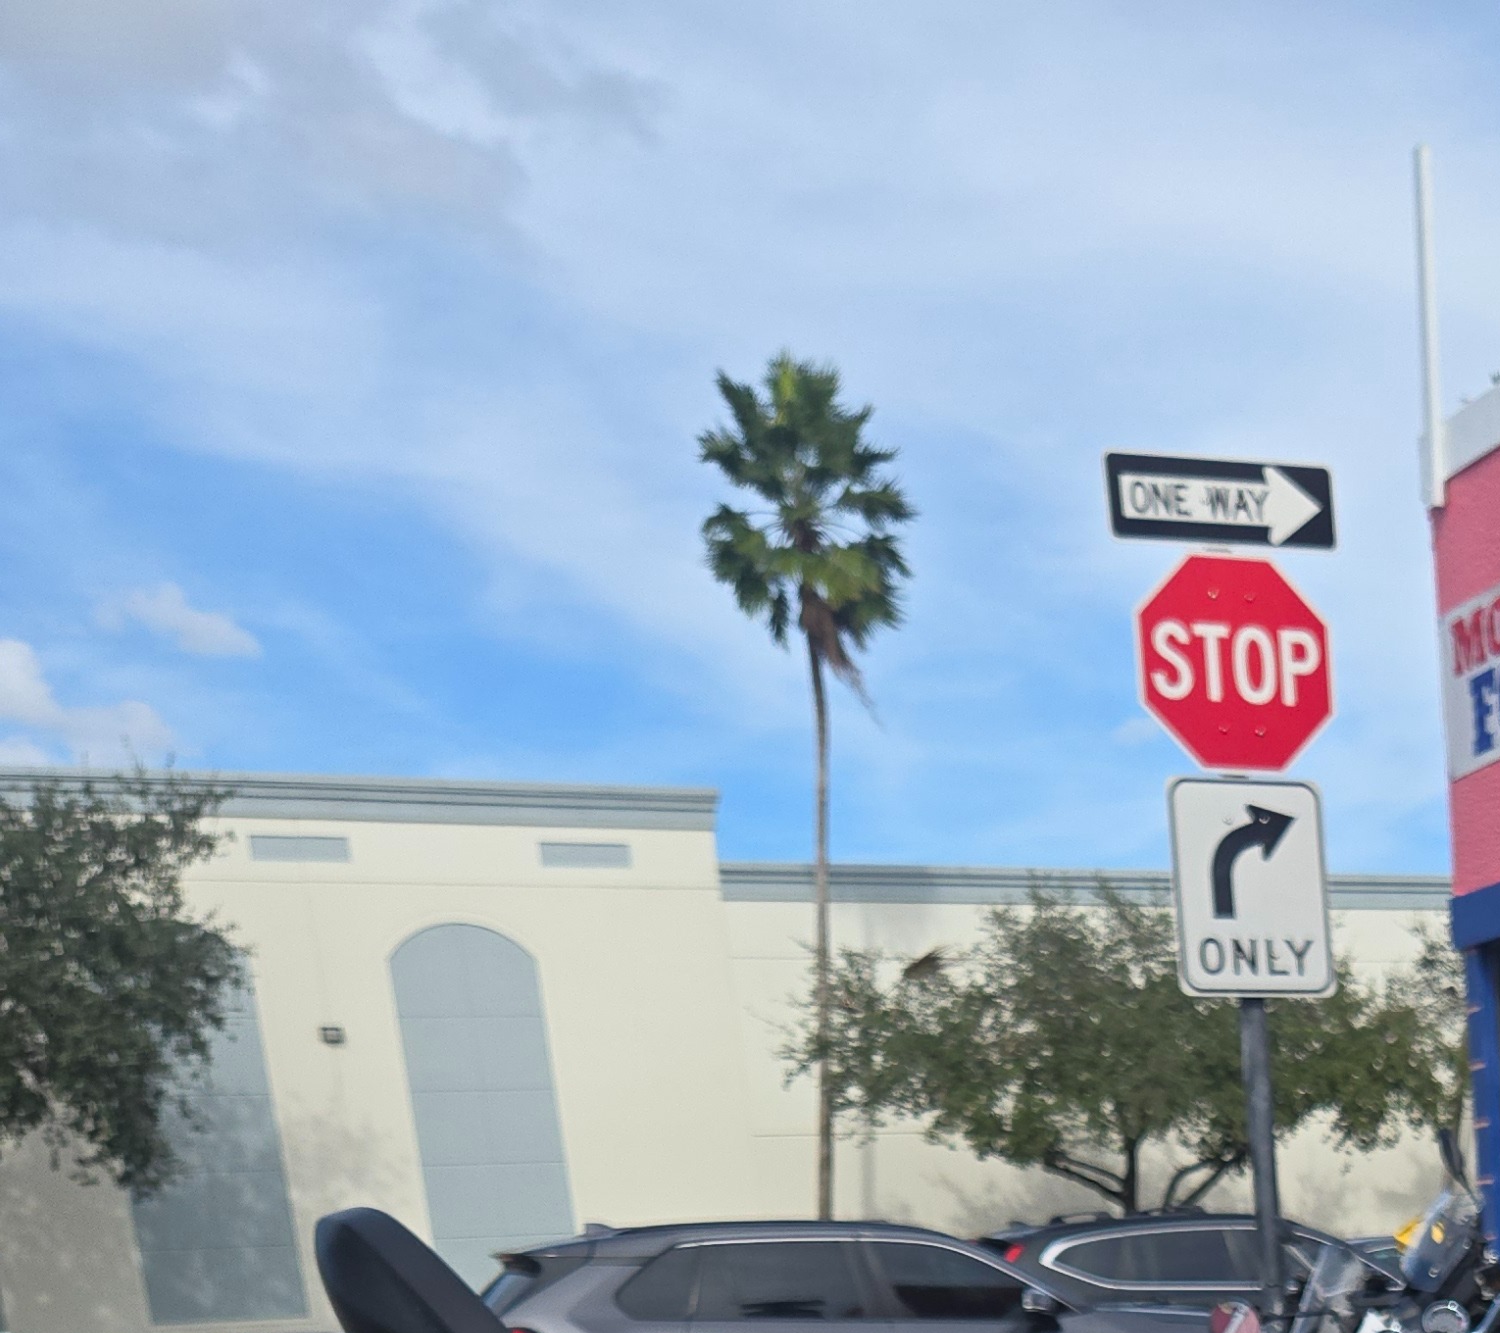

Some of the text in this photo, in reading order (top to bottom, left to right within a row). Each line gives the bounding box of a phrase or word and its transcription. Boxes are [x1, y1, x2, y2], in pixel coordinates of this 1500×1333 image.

[1129, 480, 1269, 522] ONE WAY
[1151, 620, 1320, 706] STOP
[1199, 936, 1315, 977] ONLY
